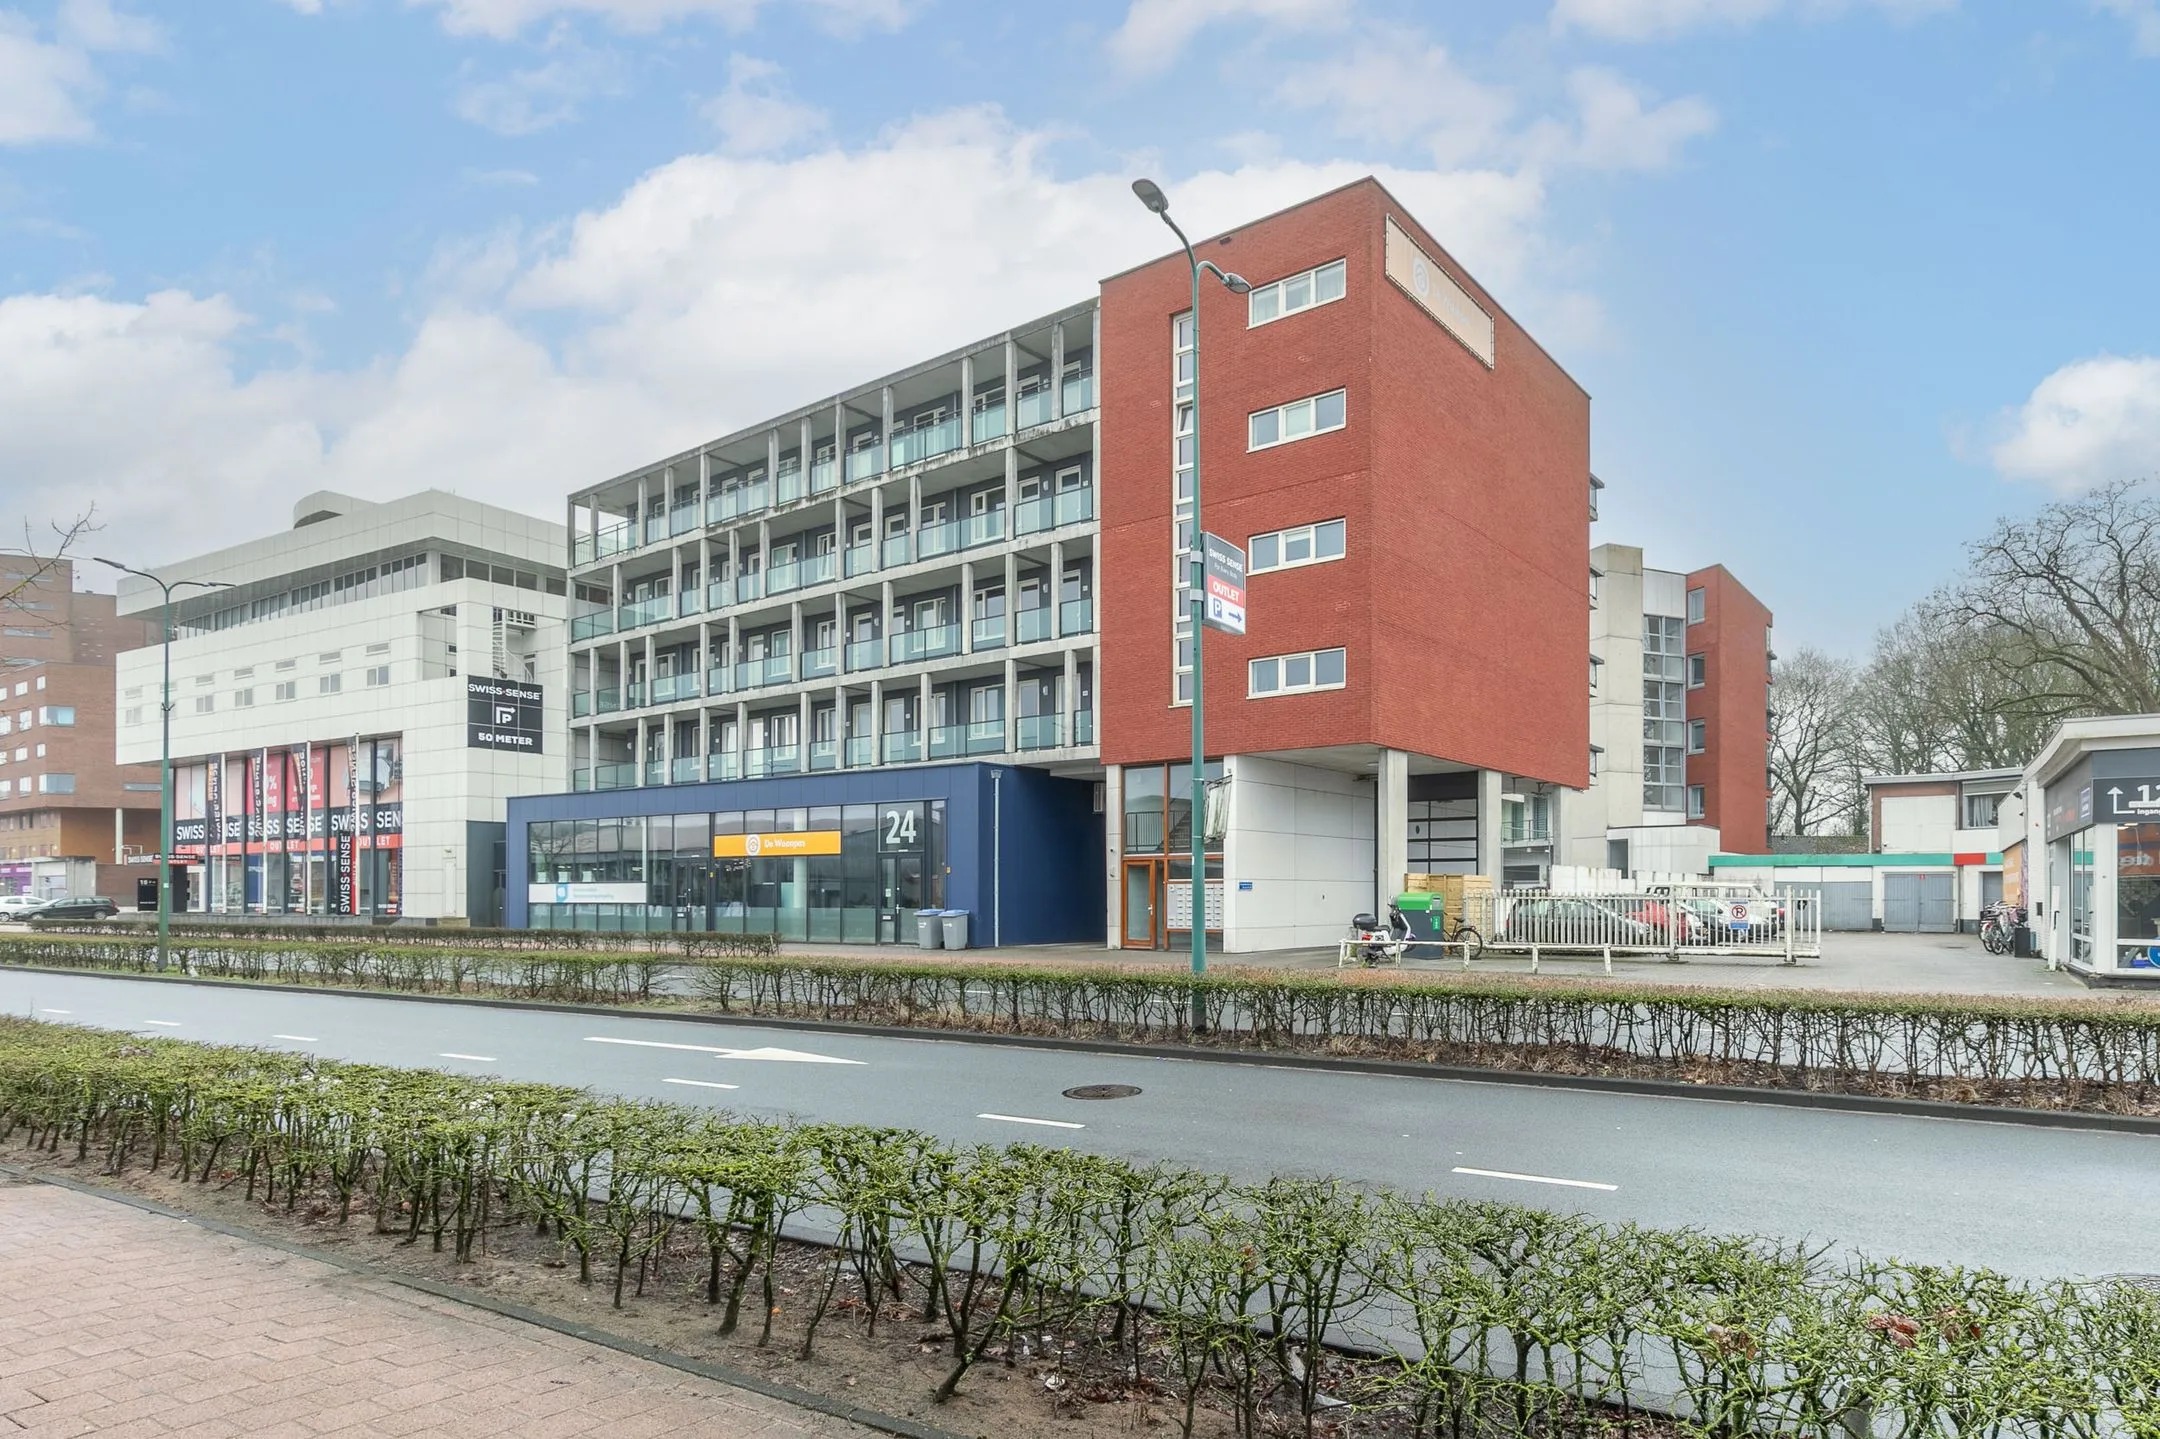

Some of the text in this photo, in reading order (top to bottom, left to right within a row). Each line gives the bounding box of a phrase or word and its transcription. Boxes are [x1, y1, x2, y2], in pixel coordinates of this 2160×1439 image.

[1209, 548, 1226, 564] SWISS
[1226, 557, 1243, 573] SENSE
[1212, 580, 1240, 602] OUTLET
[468, 683, 541, 700] SWISS SENSE
[502, 713, 512, 723] P
[478, 732, 533, 746] 50 METER
[2137, 808, 2160, 816] Ingan
[176, 824, 205, 840] SWISS
[886, 810, 917, 844] 24
[340, 835, 351, 913] SWISS SENSE
